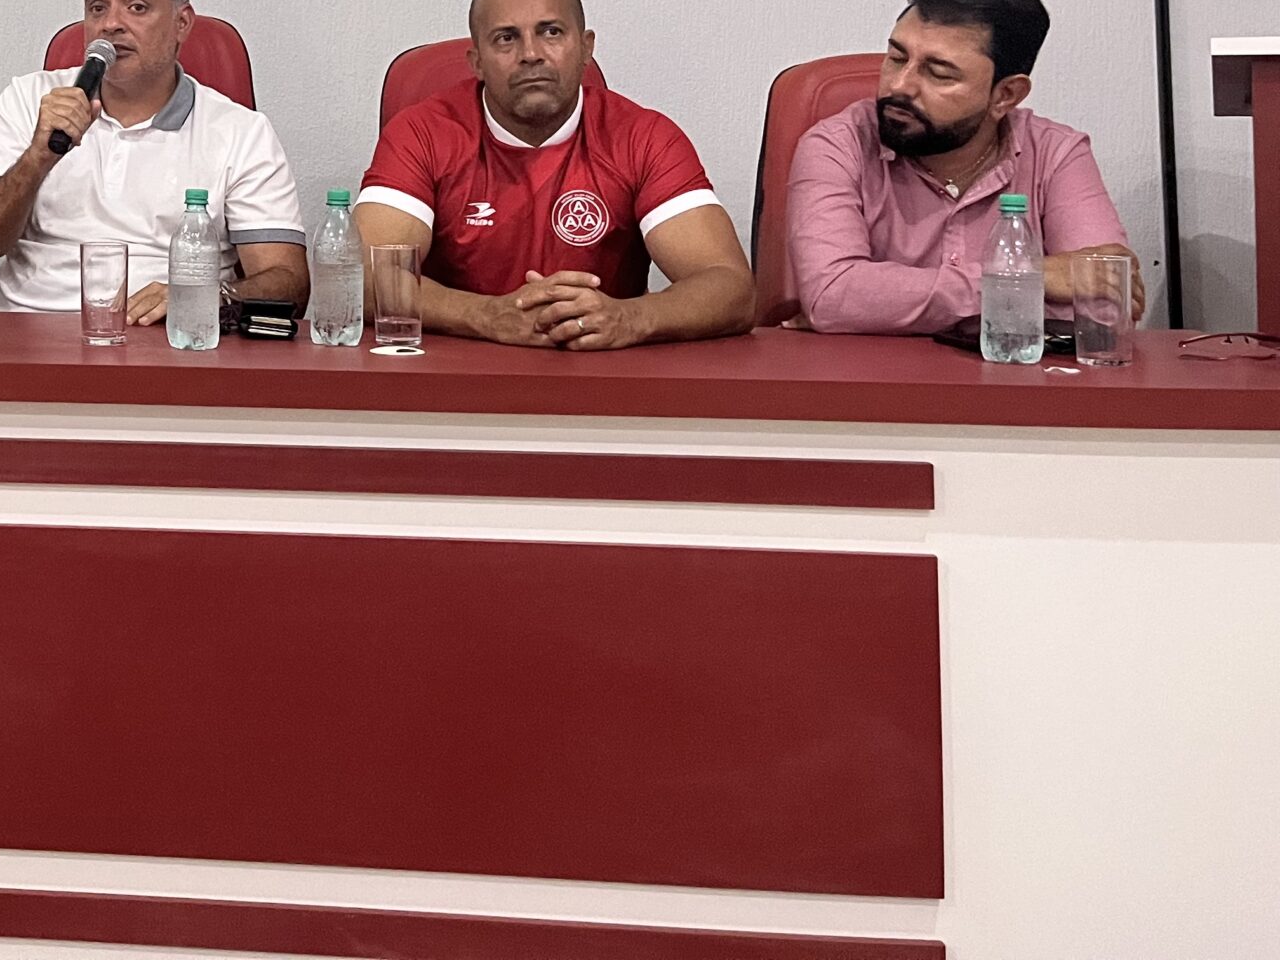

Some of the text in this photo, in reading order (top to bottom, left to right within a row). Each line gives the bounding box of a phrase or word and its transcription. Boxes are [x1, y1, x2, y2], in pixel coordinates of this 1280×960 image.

[573, 200, 586, 213] A
[466, 218, 494, 226] TOLEDO
[564, 214, 597, 228] A A
